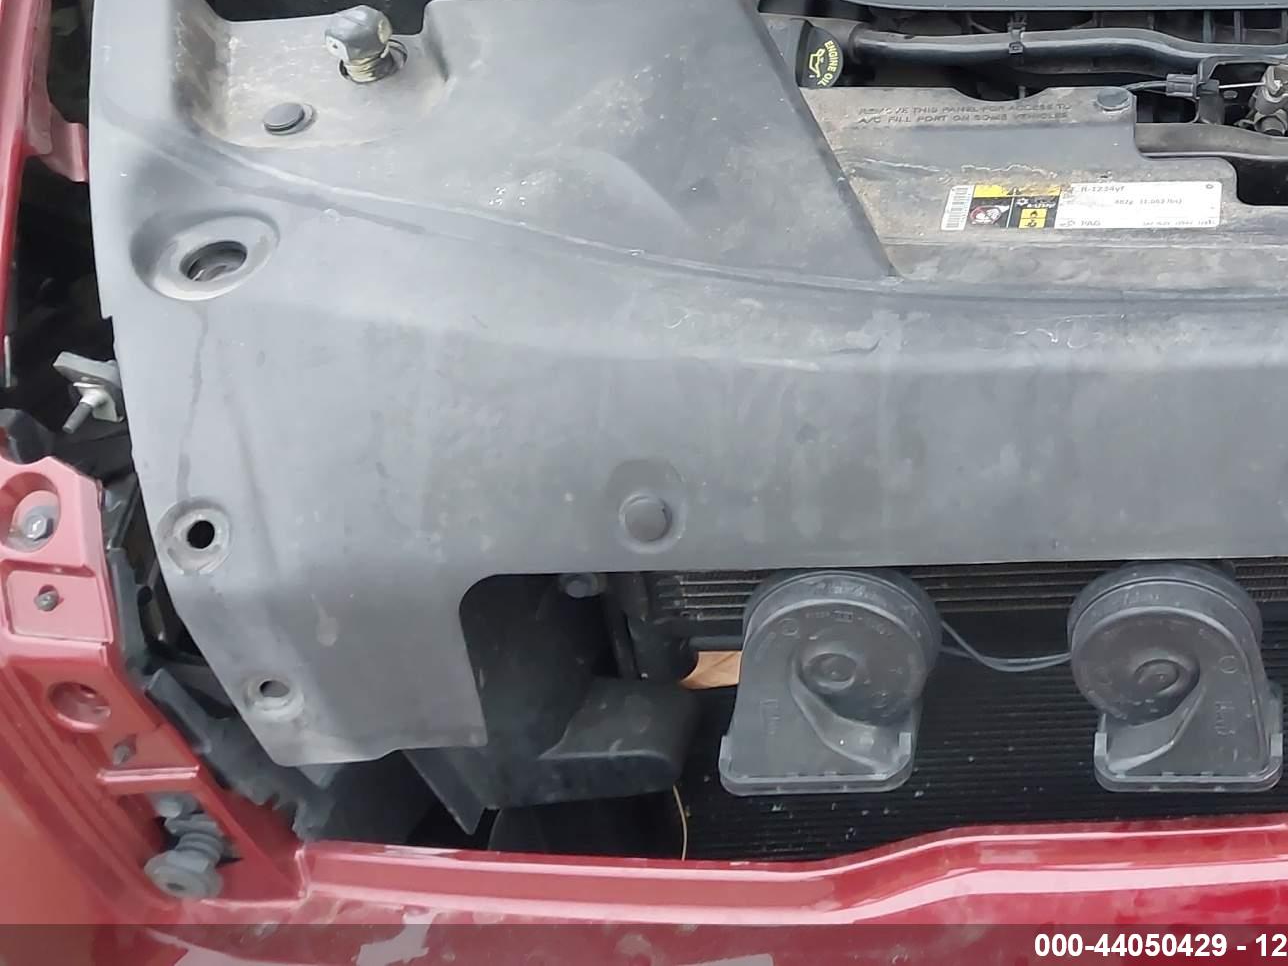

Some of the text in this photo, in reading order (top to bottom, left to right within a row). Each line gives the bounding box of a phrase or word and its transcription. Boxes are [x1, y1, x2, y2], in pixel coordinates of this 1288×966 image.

[817, 40, 839, 86] ENGINE OIL
[887, 115, 911, 123] FILL
[952, 114, 970, 122] ON
